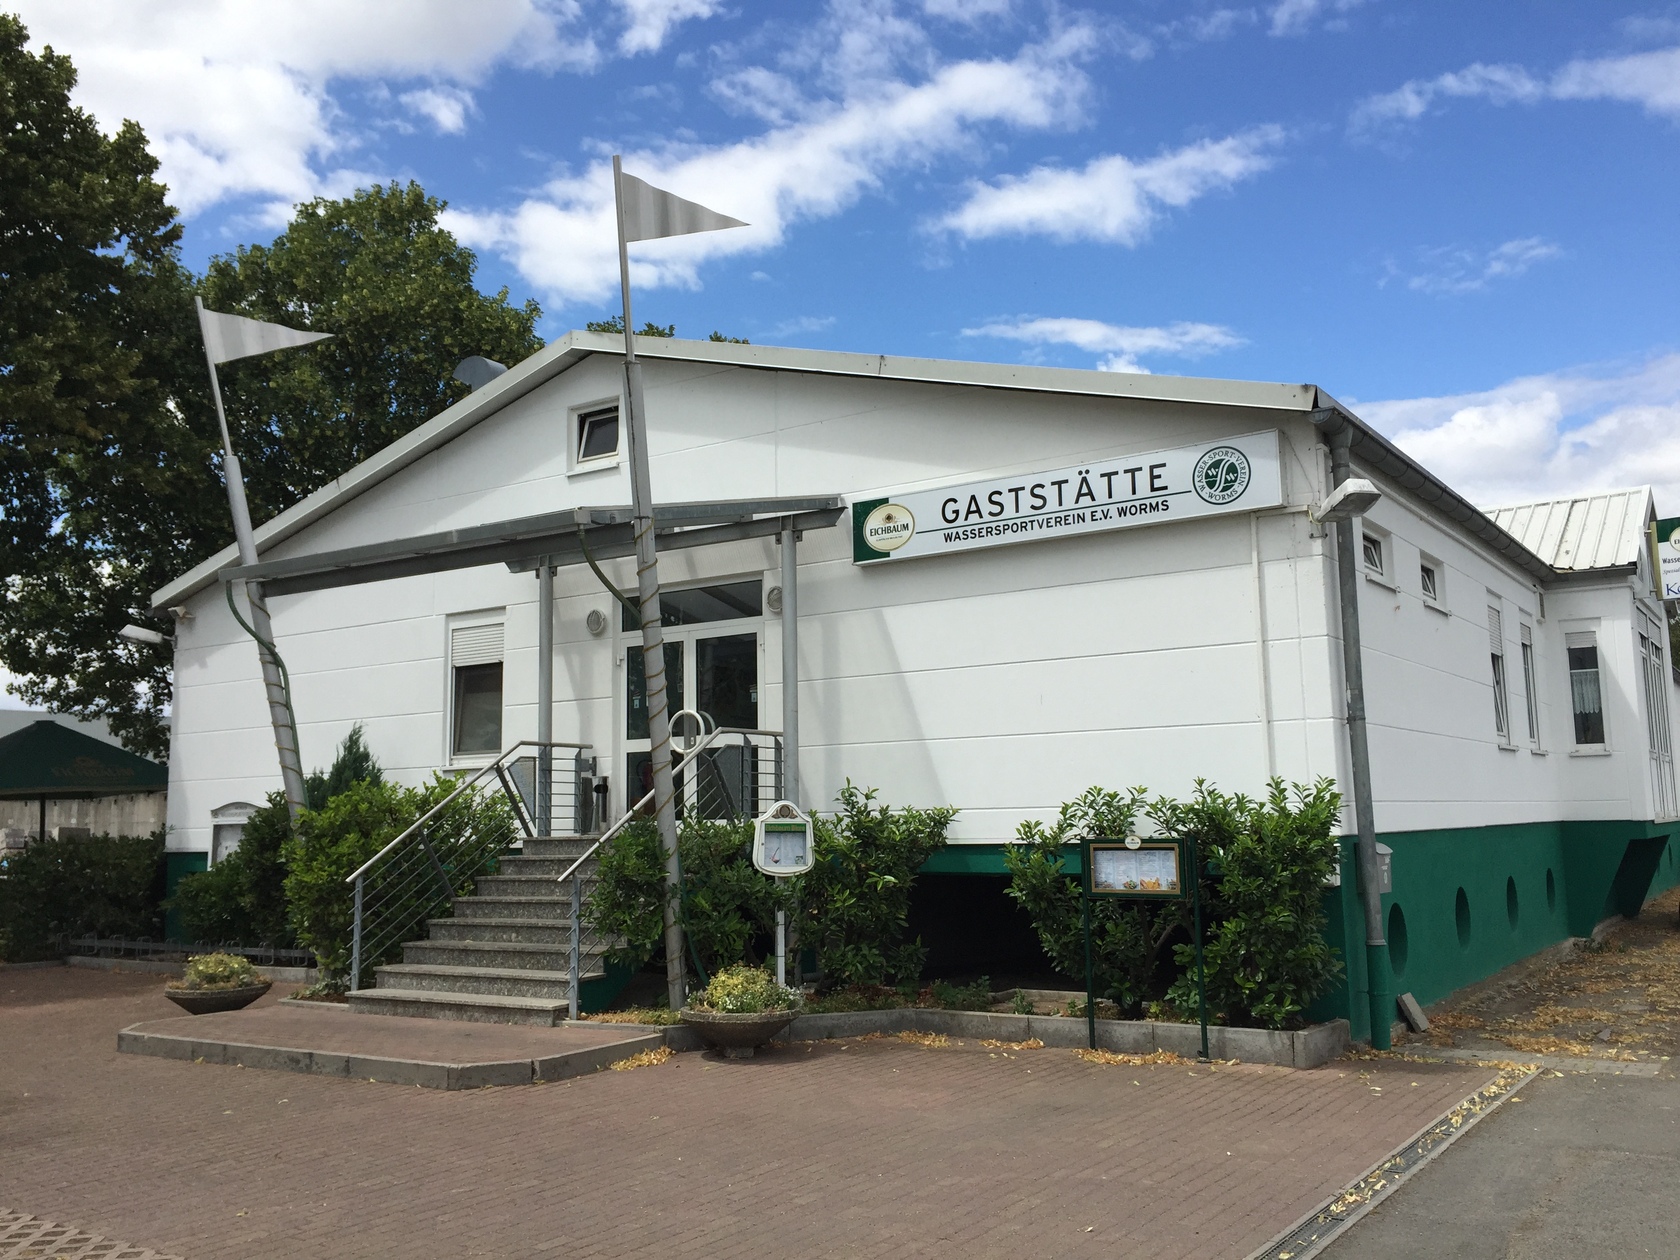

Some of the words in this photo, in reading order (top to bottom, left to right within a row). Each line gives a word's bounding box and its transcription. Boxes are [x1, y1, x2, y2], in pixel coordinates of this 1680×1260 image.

[941, 462, 1169, 524] GASTSTÄTTE
[869, 522, 910, 537] EICHBAUM
[943, 511, 1086, 543] WASSERSPORTVEREIN
[1090, 508, 1113, 522] E.V.
[1117, 499, 1170, 518] WORMS
